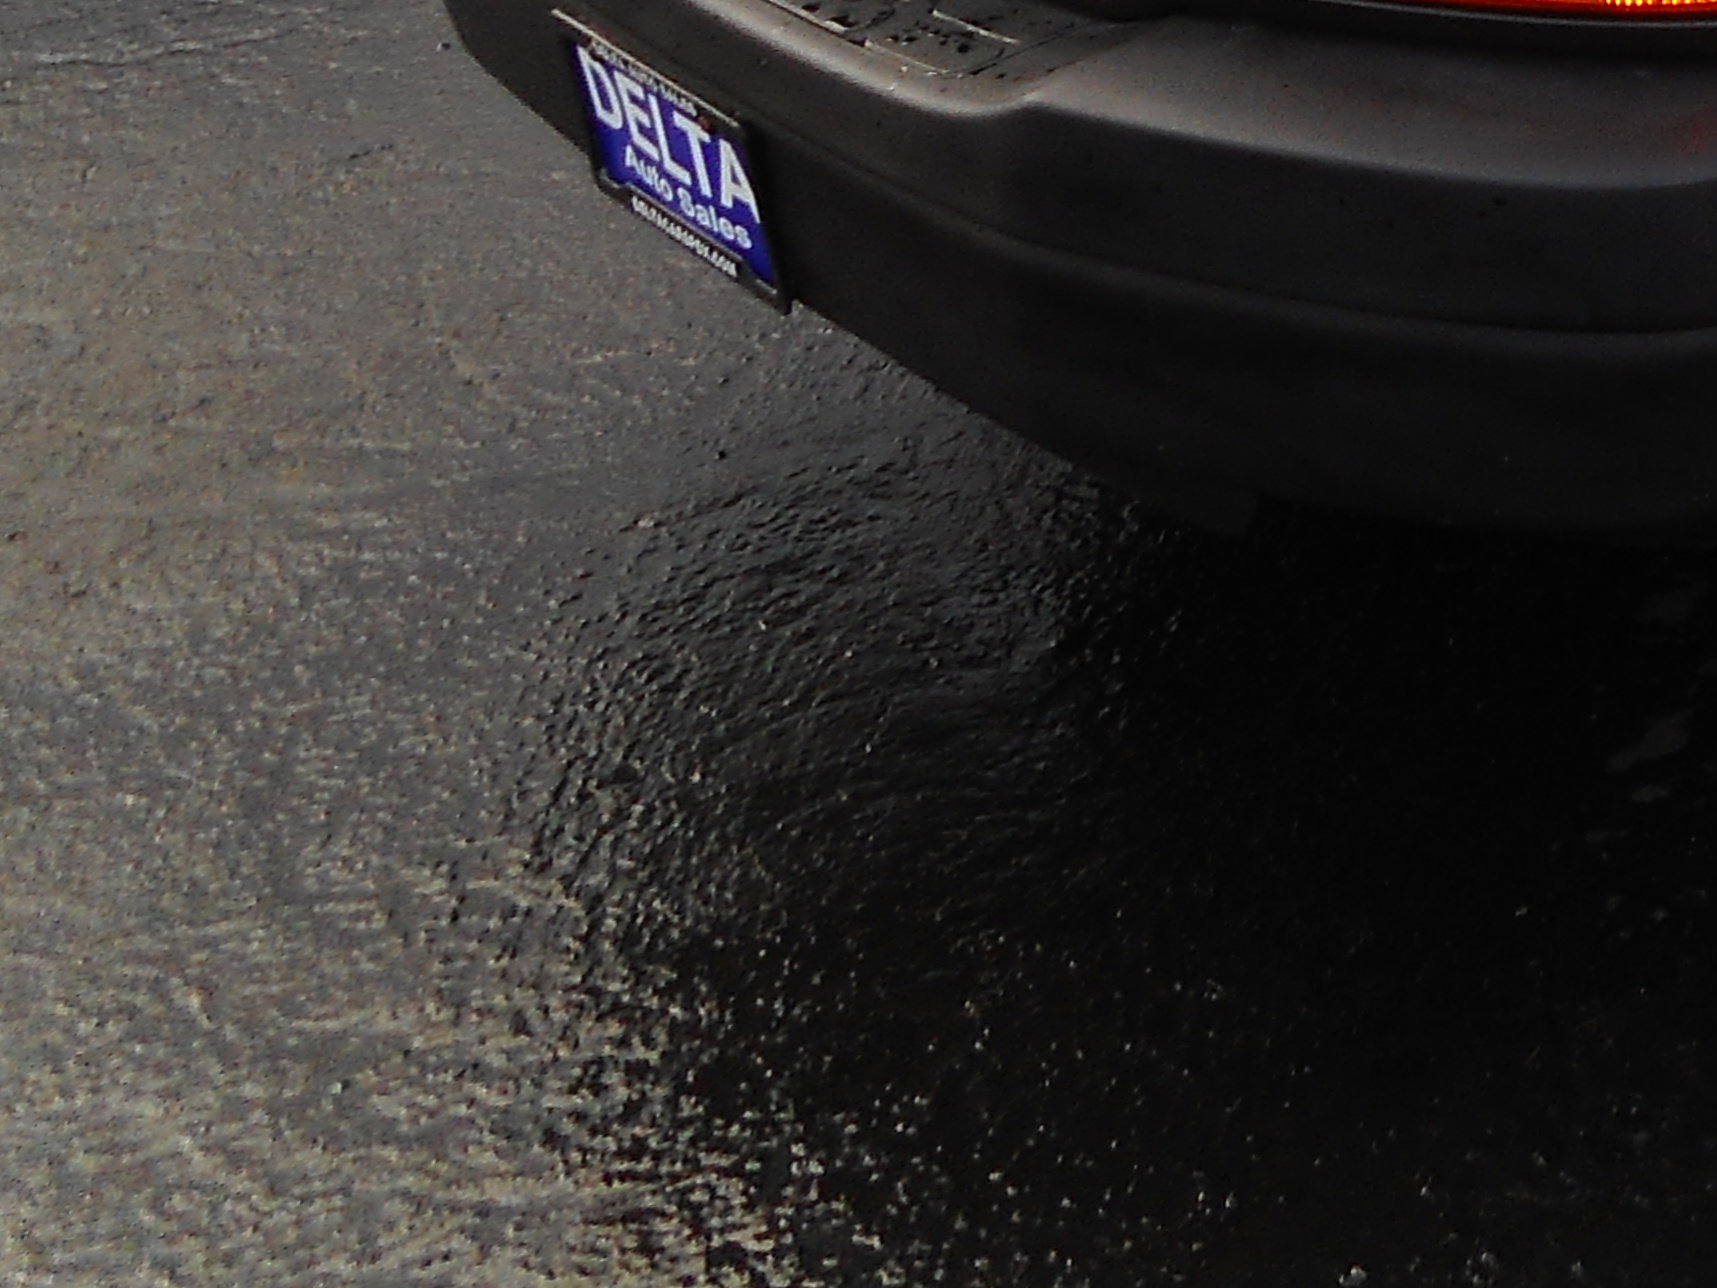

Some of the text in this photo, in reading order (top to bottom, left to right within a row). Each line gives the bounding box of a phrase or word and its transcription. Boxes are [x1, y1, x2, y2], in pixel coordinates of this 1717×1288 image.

[577, 45, 761, 224] DELTA
[625, 145, 673, 202] Auto
[677, 187, 752, 249] Sales
